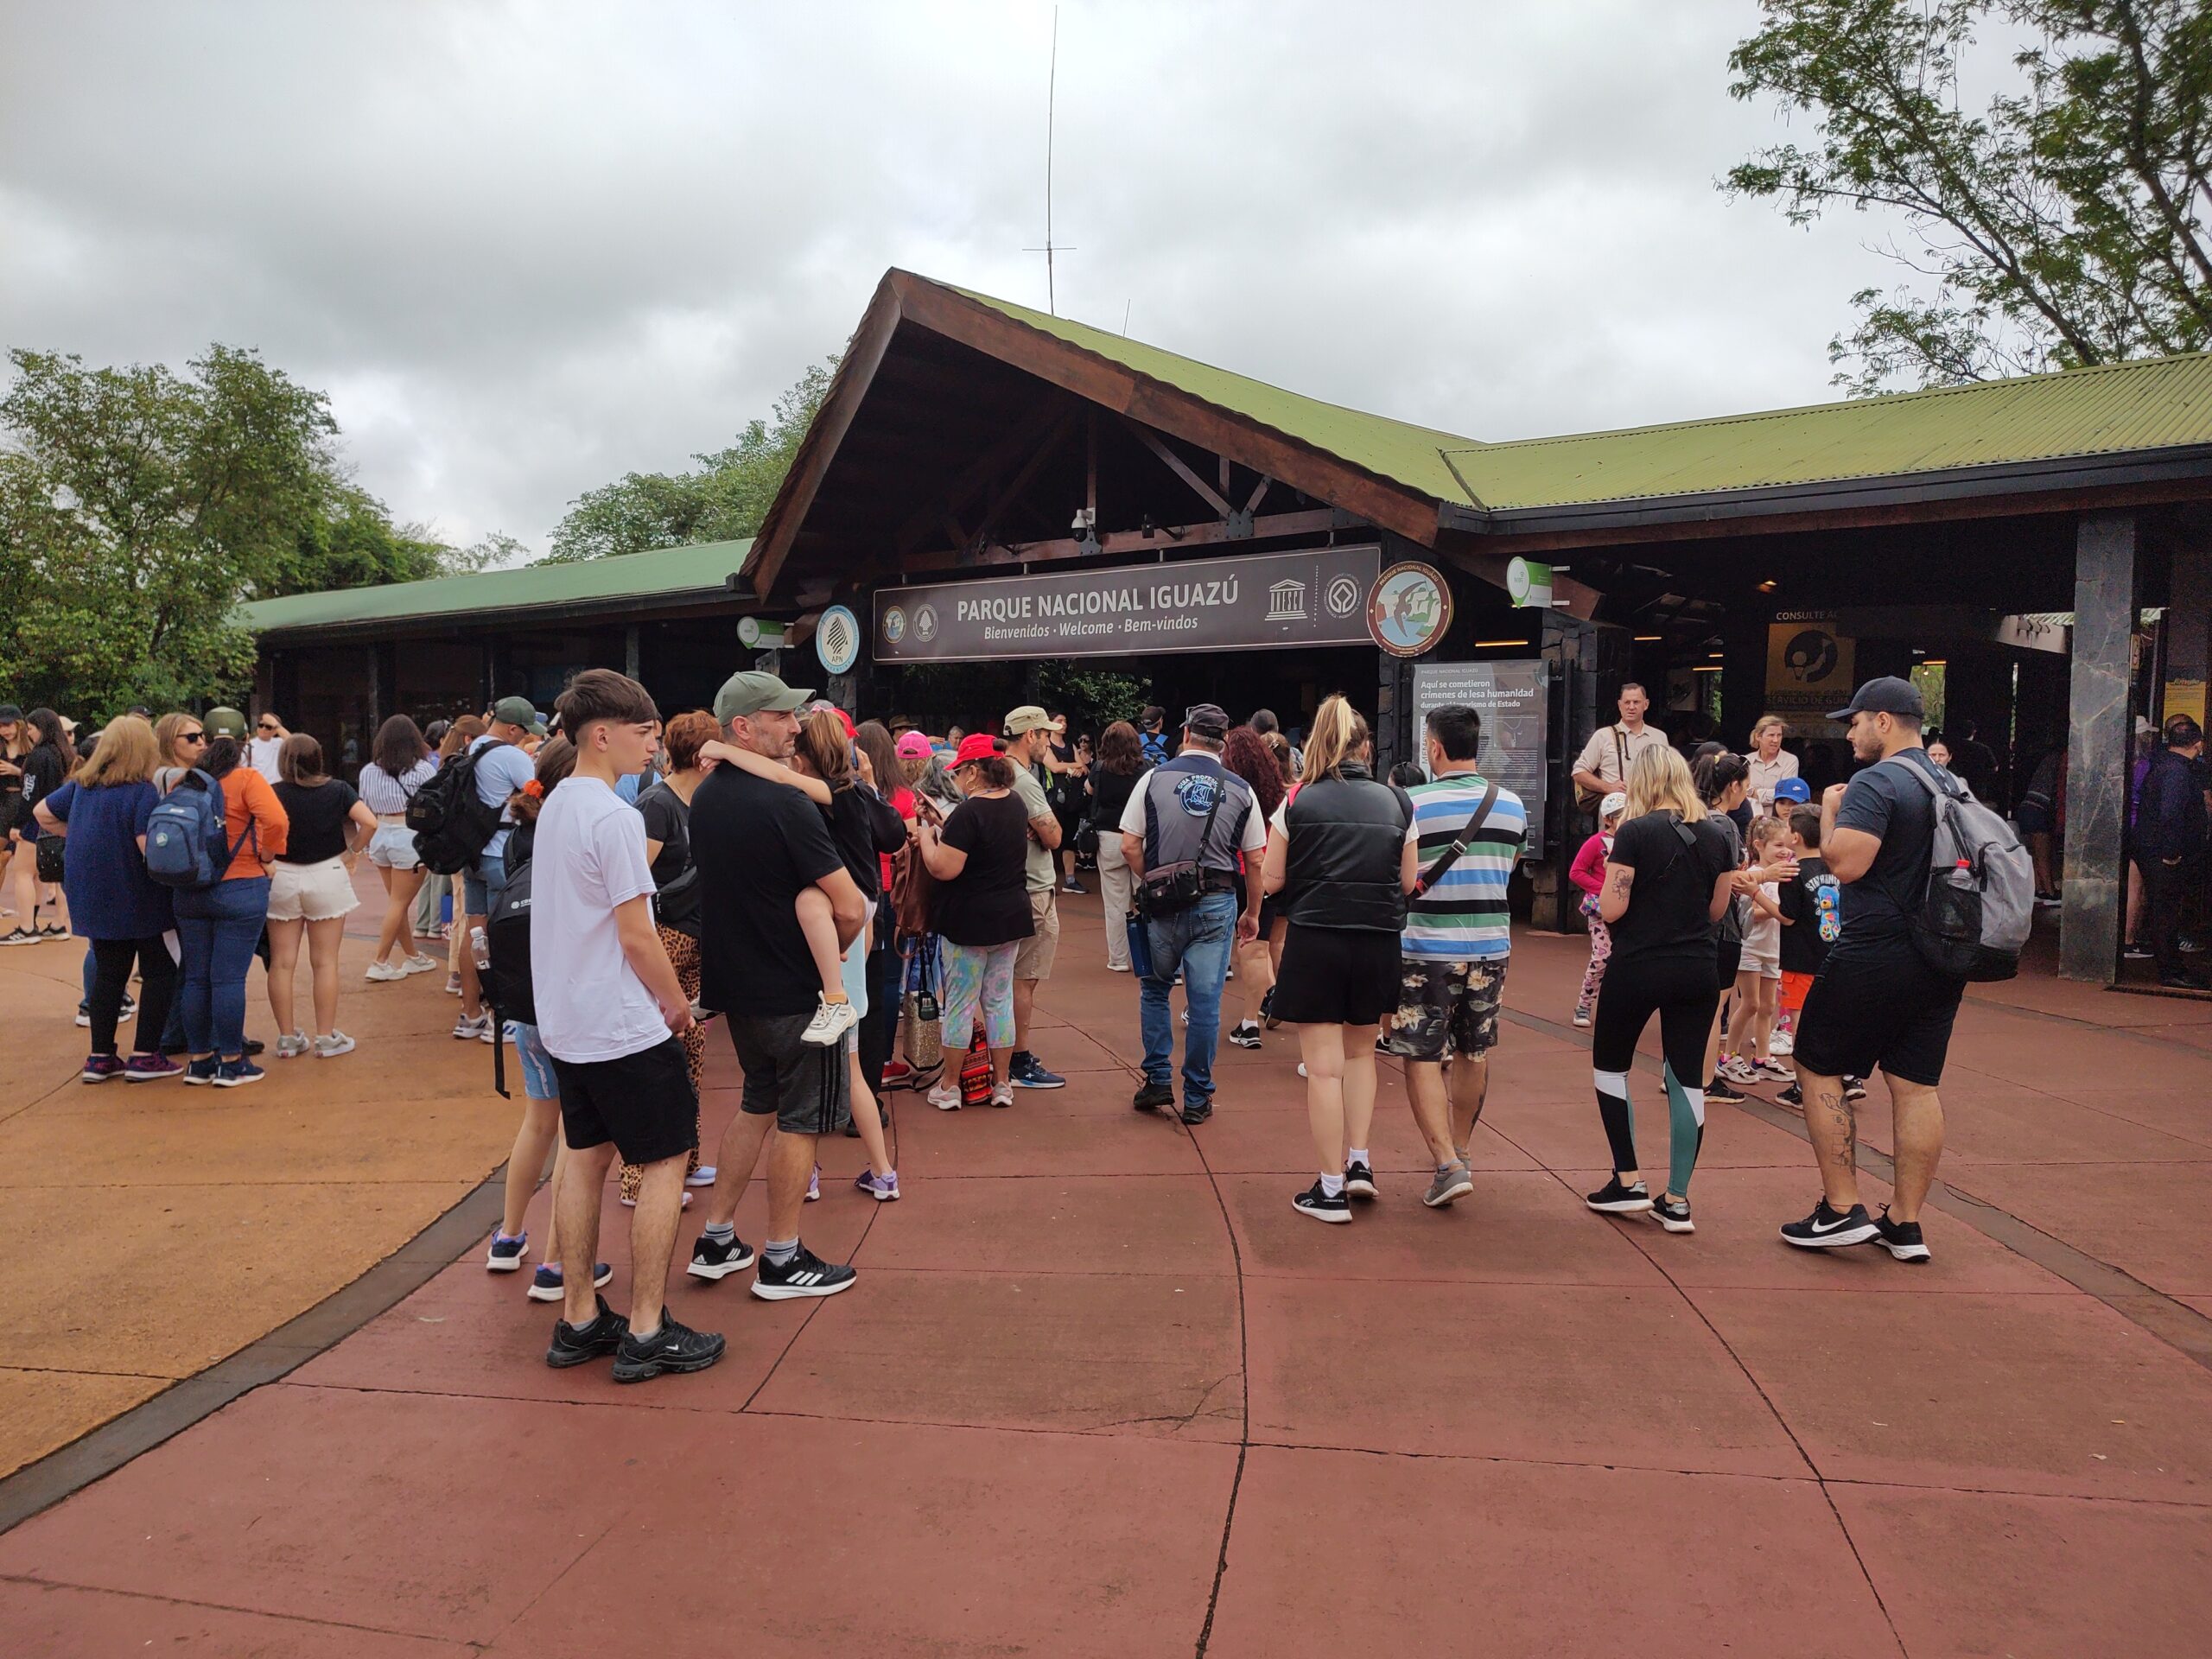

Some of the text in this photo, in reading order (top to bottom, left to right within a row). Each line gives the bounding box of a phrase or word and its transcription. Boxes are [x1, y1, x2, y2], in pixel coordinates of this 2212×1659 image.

[957, 574, 1238, 623] PARQUE NACIONAL IGUAZÚ
[1270, 589, 1304, 612] UNESCO
[1776, 610, 1825, 620] CONSULTE
[984, 614, 1198, 639] Bienvenidos Welcome Bem-vindos
[1421, 680, 1438, 690] Aquí
[1448, 679, 1491, 688] cometieron
[1421, 688, 1534, 699] crímenes de lesa humanidad
[1497, 699, 1521, 708] Estado
